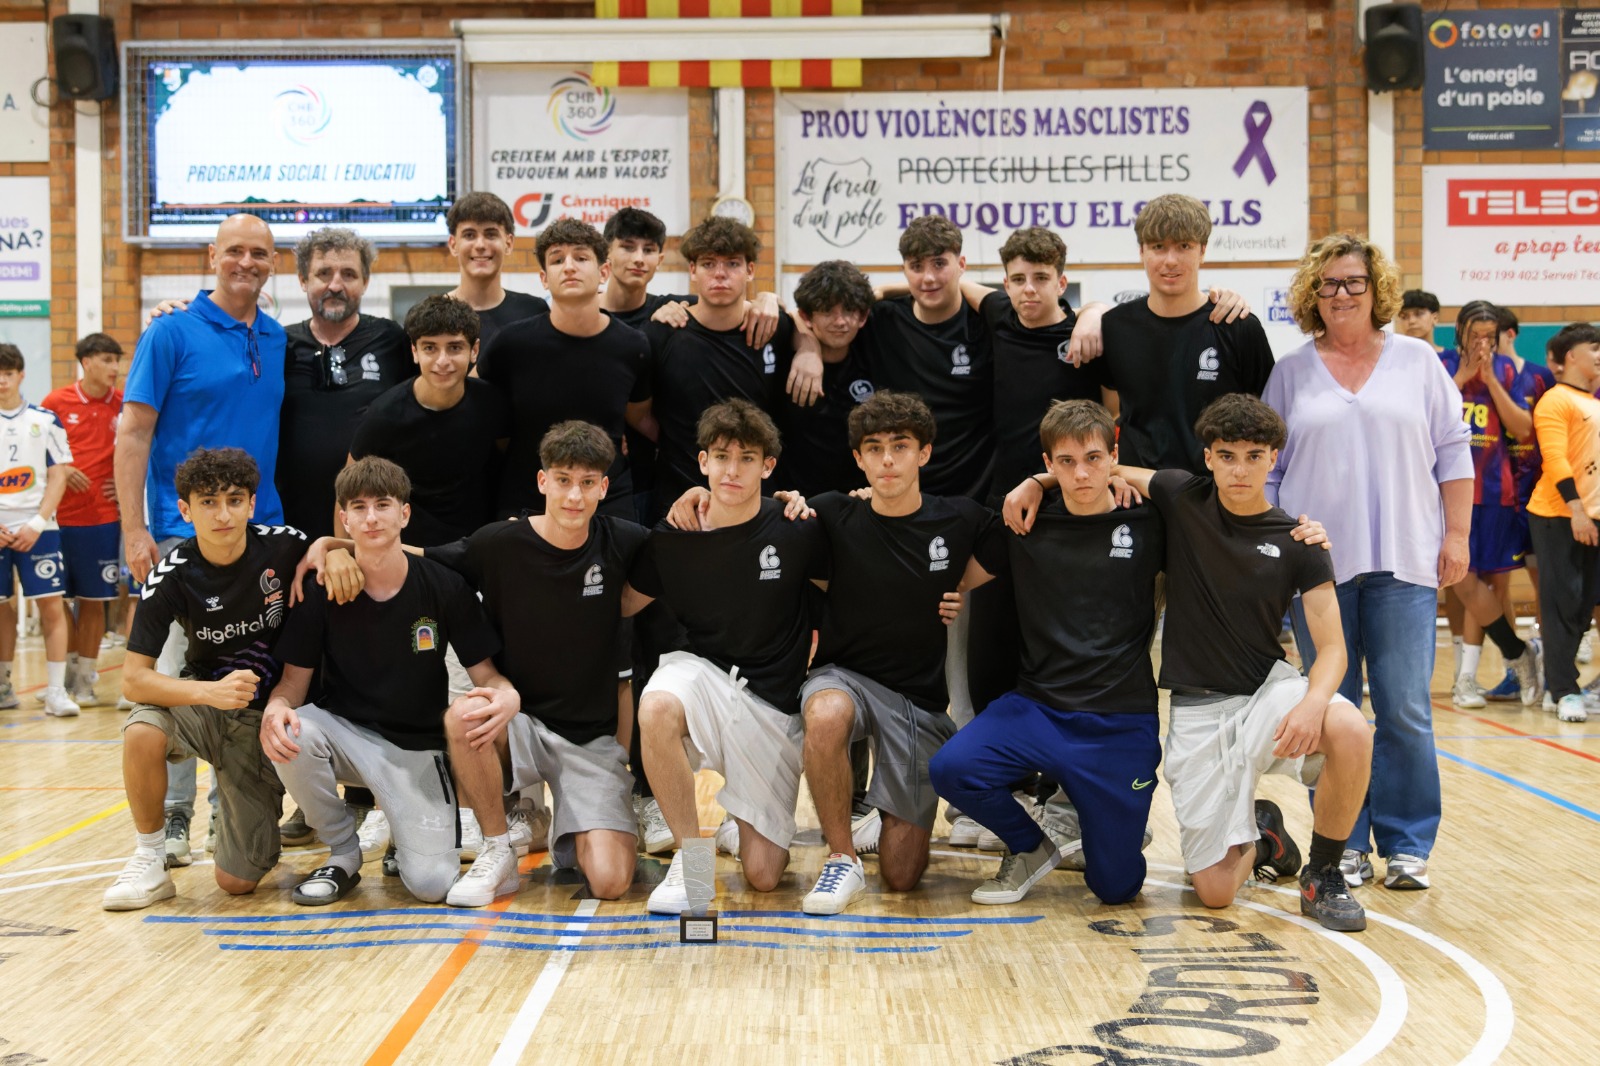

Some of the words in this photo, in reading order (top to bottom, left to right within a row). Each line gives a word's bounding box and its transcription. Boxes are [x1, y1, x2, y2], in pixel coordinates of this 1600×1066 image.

[1444, 64, 1538, 88] L'energia
[565, 91, 595, 103] CHB
[1437, 88, 1484, 107] d'un
[1487, 87, 1545, 111] poble
[566, 106, 596, 119] 360
[801, 109, 868, 138] PROU
[876, 101, 1027, 138] VIOLÈNCIES
[1034, 106, 1190, 136] MASCLISTES
[491, 150, 556, 163] CREIXEM
[562, 150, 595, 163] AMB
[601, 149, 672, 164] L'ESPORT,
[187, 164, 272, 182] PROGRAMA
[277, 164, 327, 181] SOCIAL
[334, 163, 339, 181] I
[344, 162, 416, 181] EDUCATIU
[497, 166, 569, 179] EDUQUEM
[575, 166, 607, 179] AMB
[615, 166, 669, 179] VALORS
[898, 157, 1037, 184] PROTEGIU
[1047, 155, 1094, 182] LES
[1104, 154, 1191, 182] FILLES
[792, 161, 815, 196] La
[822, 170, 881, 205] força
[561, 194, 651, 209] Càrniques
[1458, 189, 1600, 215] TELEC
[834, 198, 887, 238] poble
[1213, 234, 1286, 250] #diversitat
[1495, 241, 1509, 254] a
[1512, 238, 1567, 261] prop
[1469, 269, 1491, 281] 902
[1495, 269, 1515, 281] 199
[1517, 269, 1540, 281] 402
[1542, 269, 1577, 281] Servei
[1462, 402, 1488, 428] 78
[9, 444, 18, 462] 2
